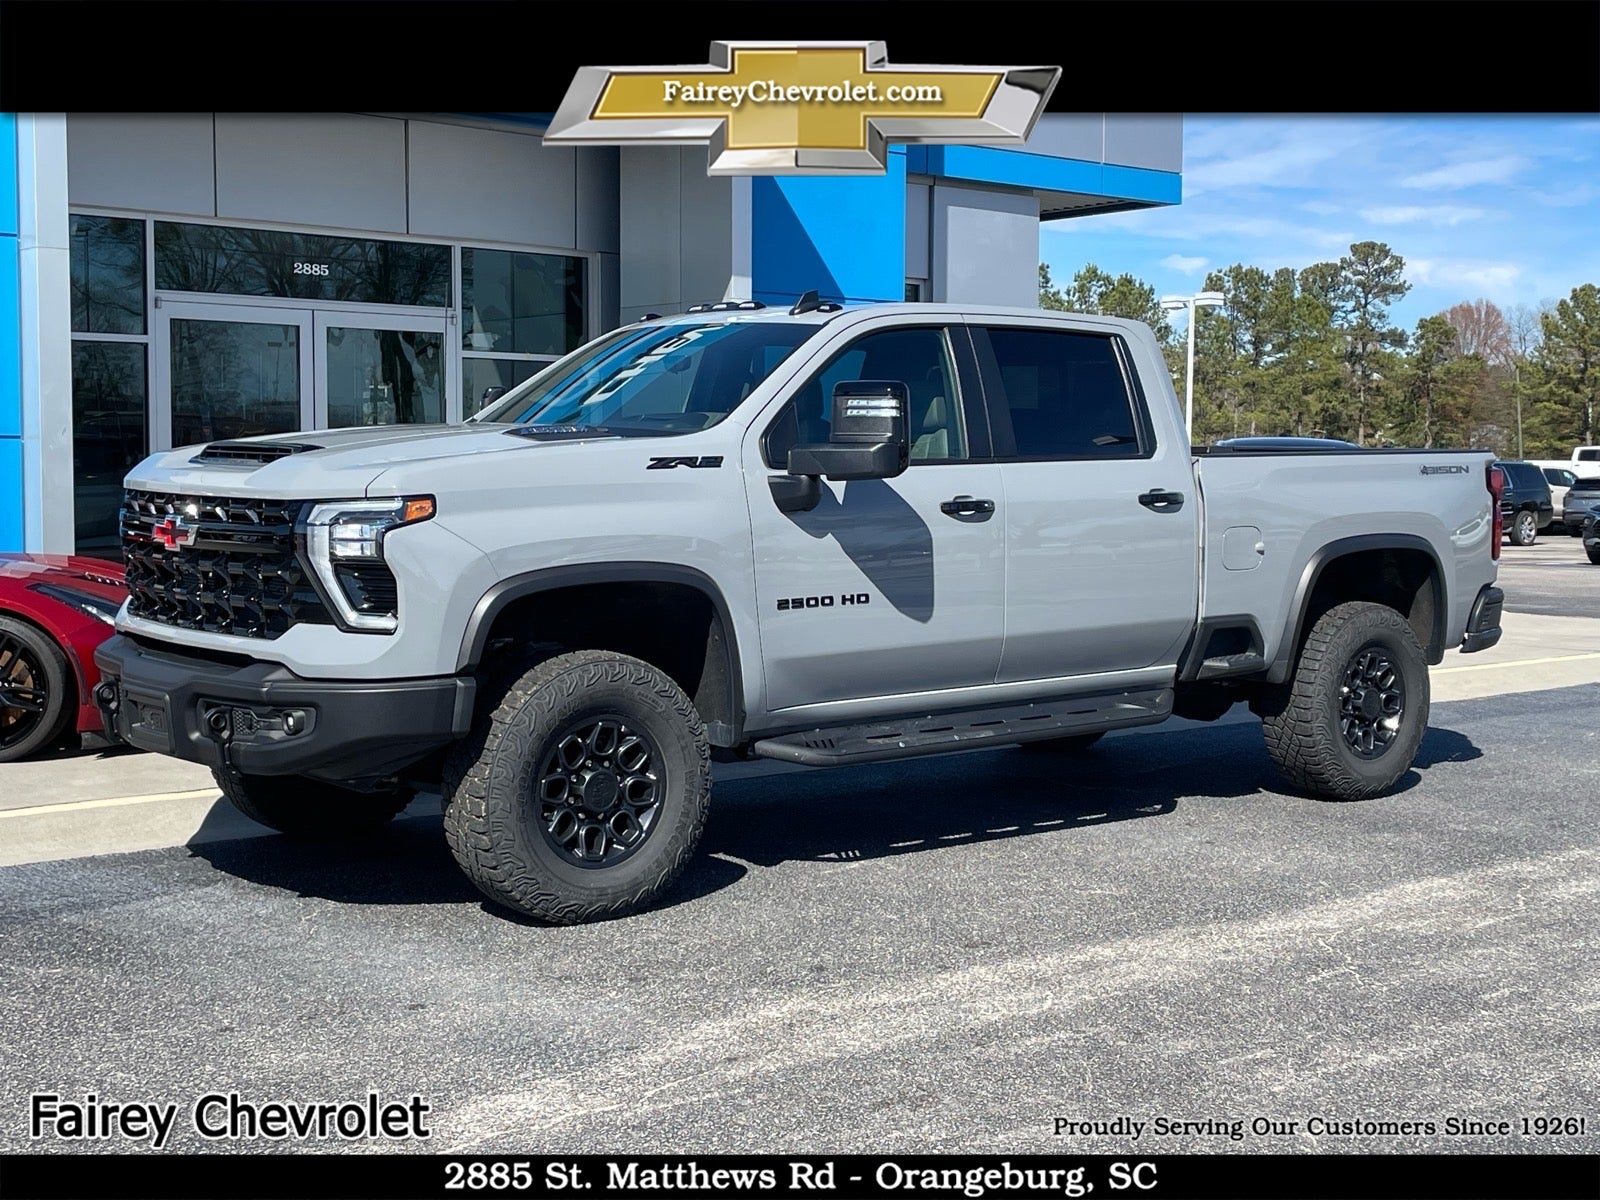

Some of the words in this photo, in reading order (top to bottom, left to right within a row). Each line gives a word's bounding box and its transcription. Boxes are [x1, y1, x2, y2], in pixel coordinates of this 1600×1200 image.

[293, 262, 329, 276] 2885
[1421, 464, 1470, 475] BISON
[776, 595, 834, 611] 2500
[841, 593, 870, 606] HD
